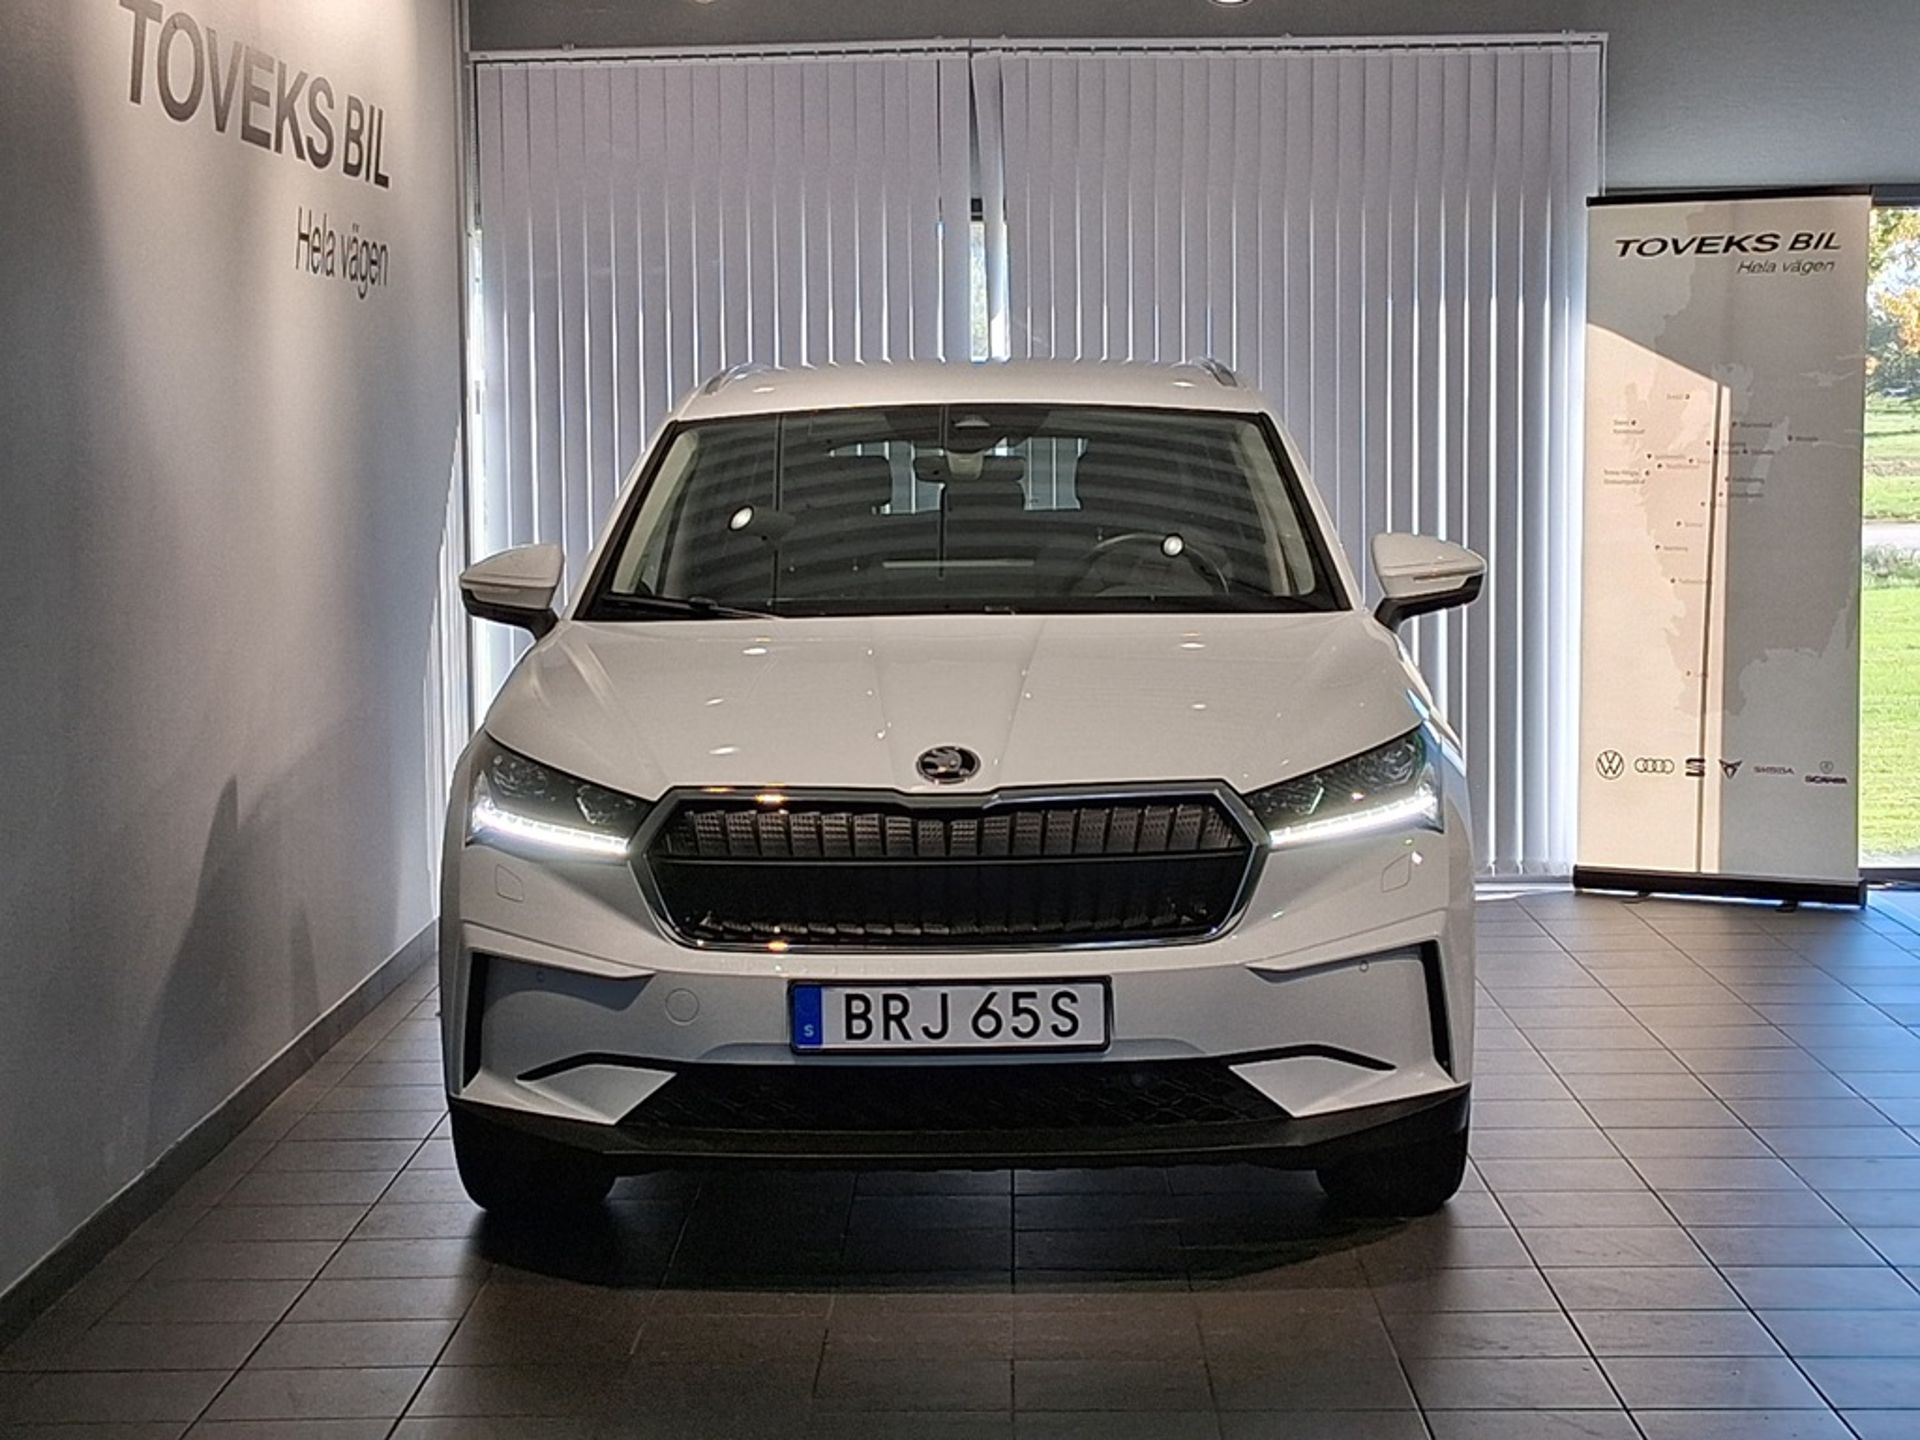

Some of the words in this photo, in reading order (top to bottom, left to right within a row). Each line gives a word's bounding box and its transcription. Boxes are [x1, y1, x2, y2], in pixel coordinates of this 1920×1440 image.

[119, 0, 335, 170] TOVEKS
[342, 95, 390, 188] BIL
[295, 207, 335, 278] Hela
[340, 223, 389, 300] vägen
[1615, 233, 1783, 257] TOVEKS
[1788, 232, 1842, 250] BIL
[1737, 260, 1776, 274] Hela
[1782, 260, 1836, 276] vägen
[803, 1023, 815, 1037] S
[844, 992, 949, 1040] BRJ
[971, 990, 1079, 1039] 65S
